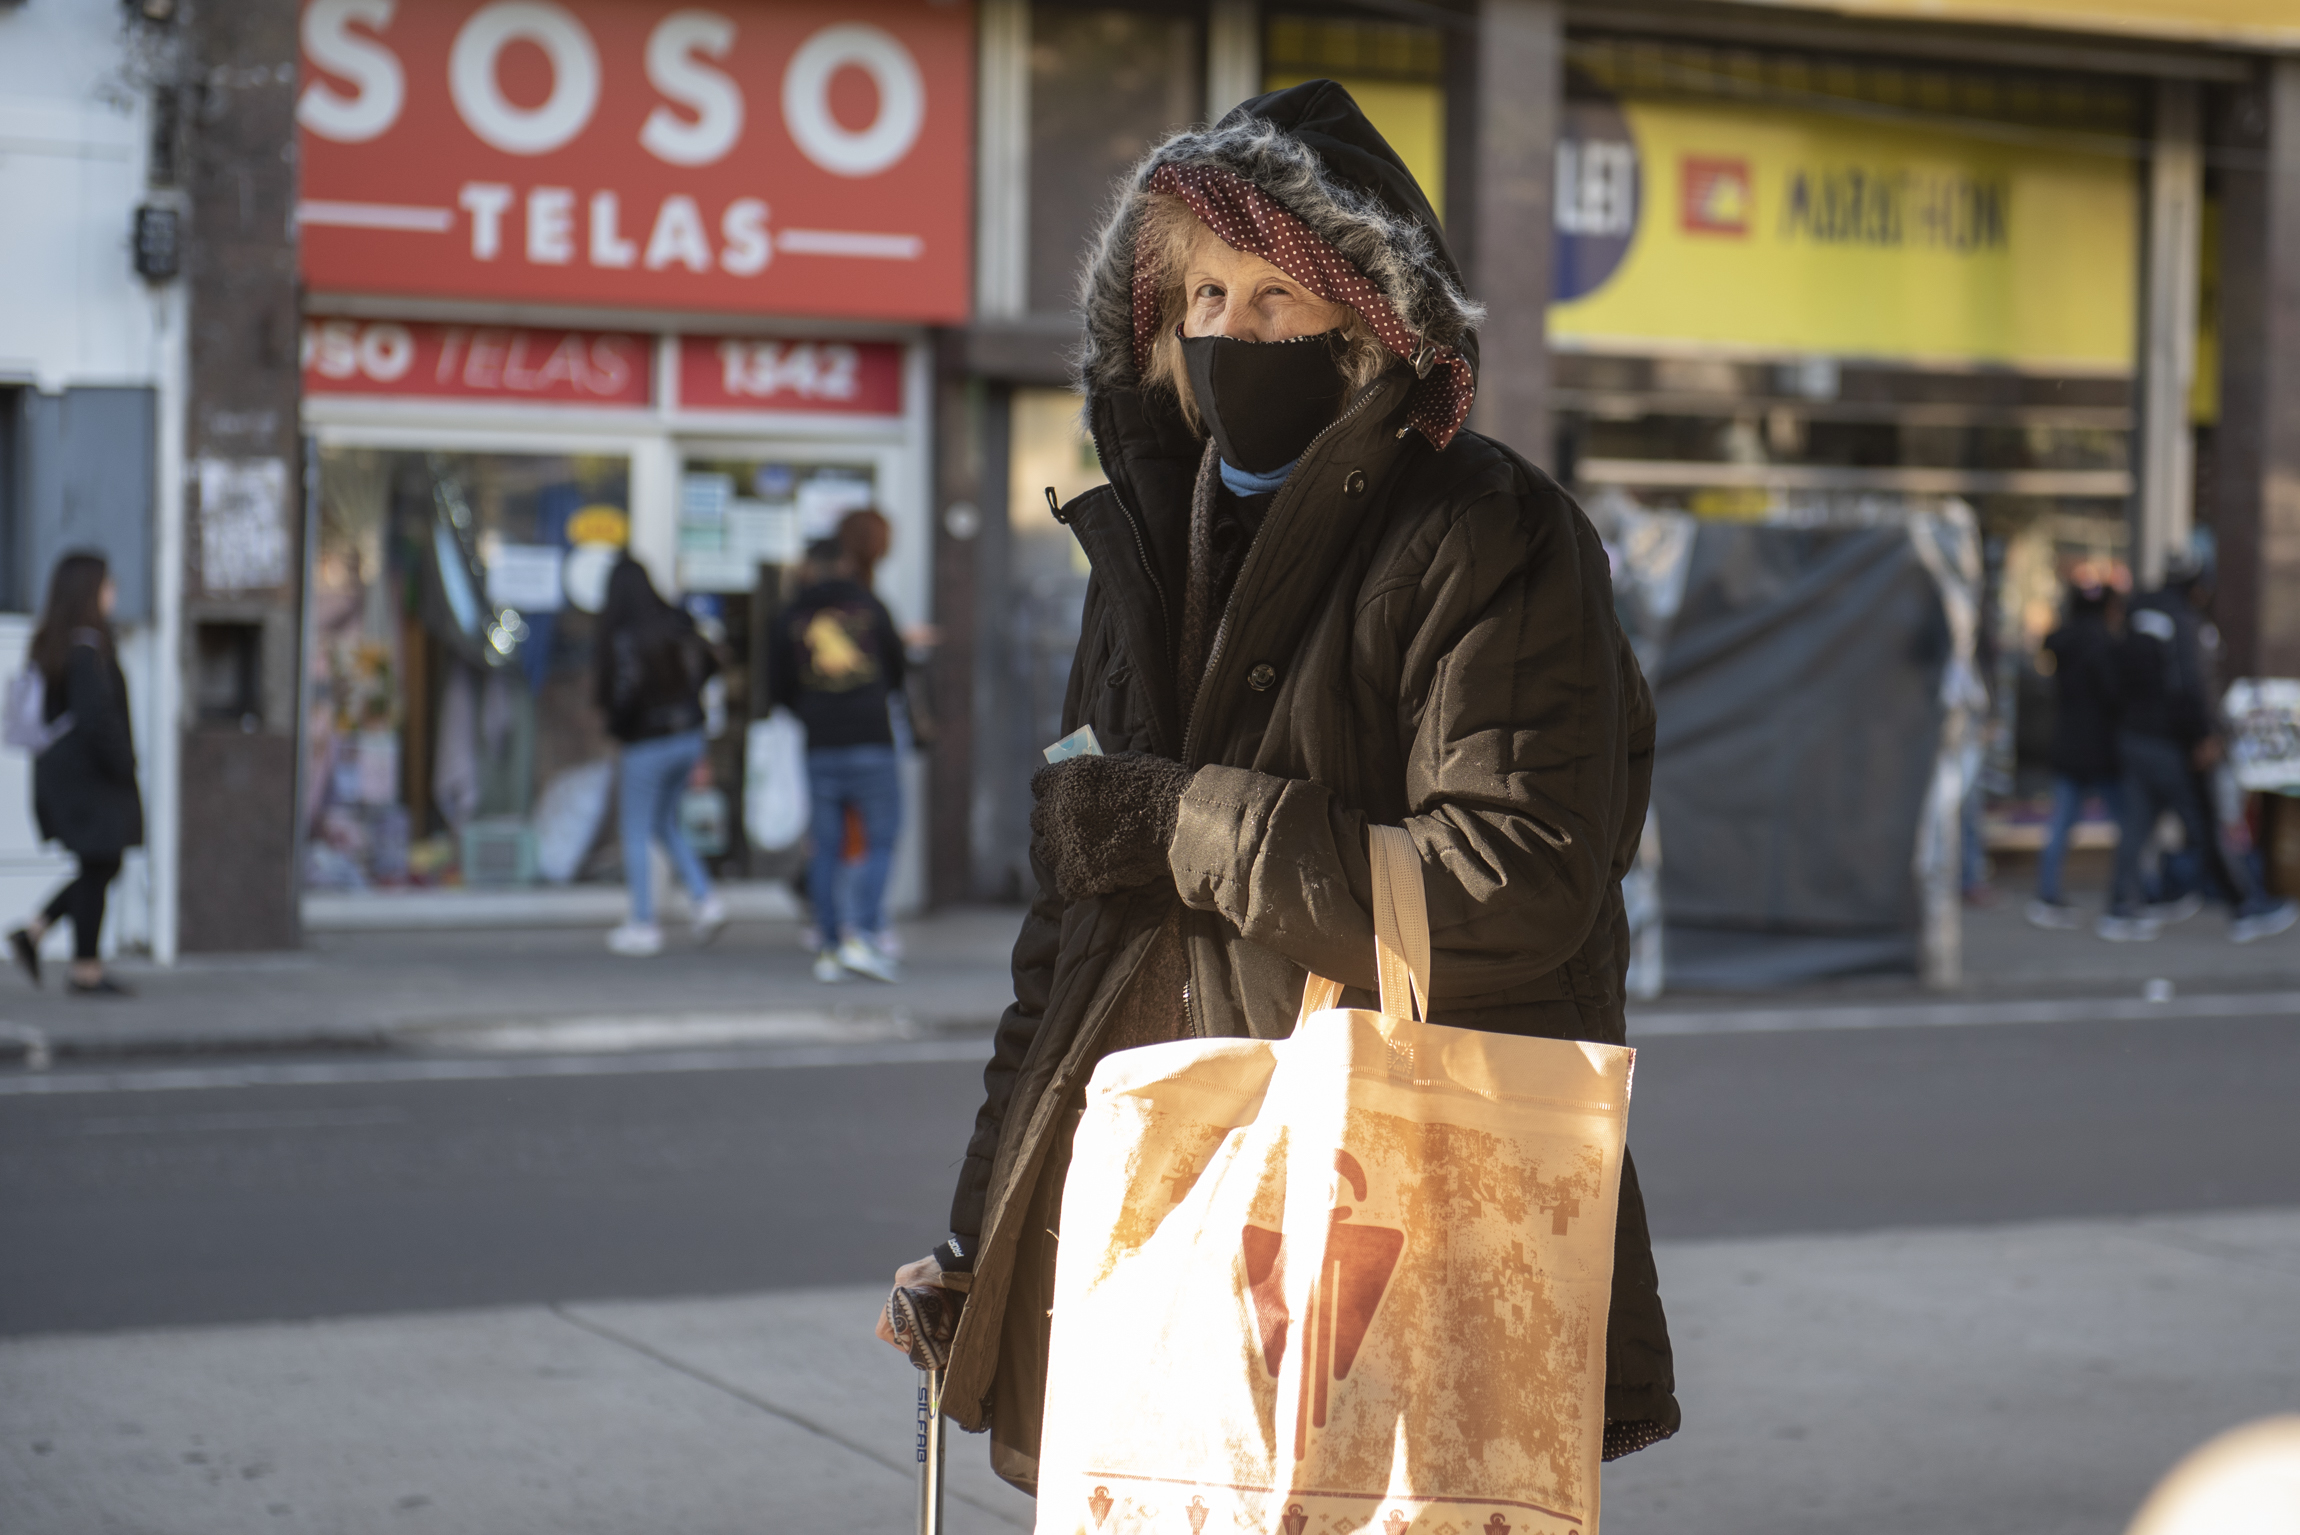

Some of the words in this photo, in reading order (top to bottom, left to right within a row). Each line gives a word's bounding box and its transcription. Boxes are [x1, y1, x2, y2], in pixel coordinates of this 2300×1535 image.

[299, 0, 925, 177] SOSO
[459, 182, 772, 276] TELAS
[435, 331, 630, 395] TELAS
[719, 339, 860, 399] 1342
[917, 1387, 928, 1463] SILFAB
